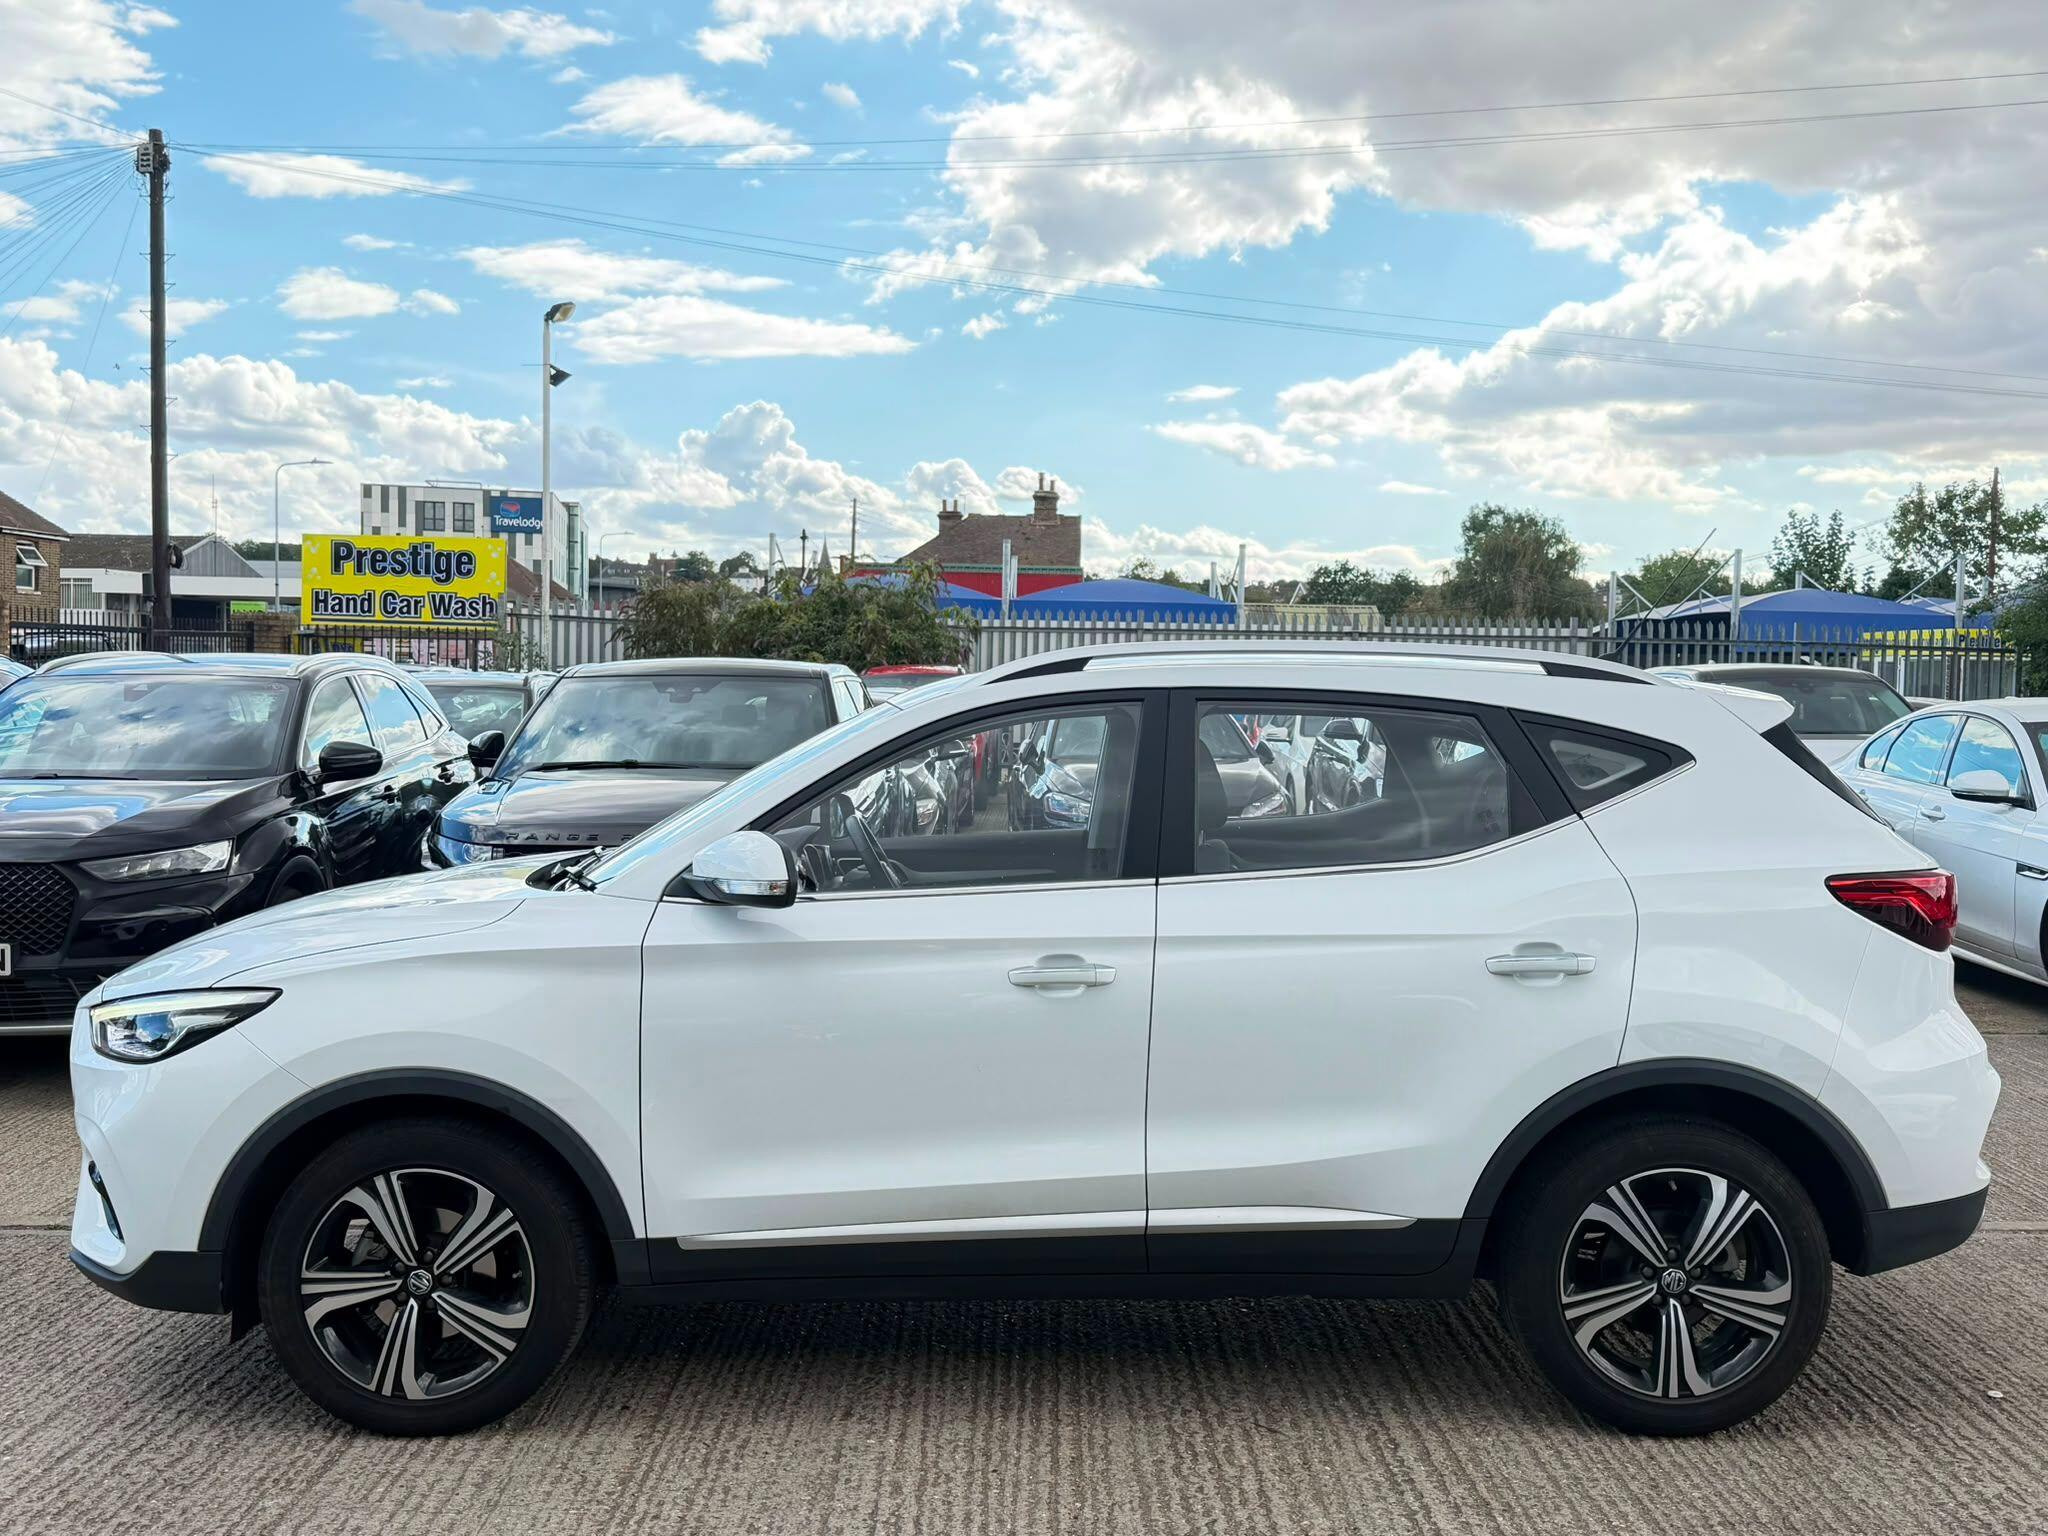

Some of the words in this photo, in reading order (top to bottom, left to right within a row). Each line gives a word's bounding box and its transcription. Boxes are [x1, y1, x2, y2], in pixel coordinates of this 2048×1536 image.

[331, 540, 476, 585] Prestige
[312, 588, 375, 616] Hand
[380, 590, 425, 619] Car
[428, 592, 498, 620] Wash
[505, 832, 600, 842] RANGE
[1664, 1271, 1684, 1291] MG
